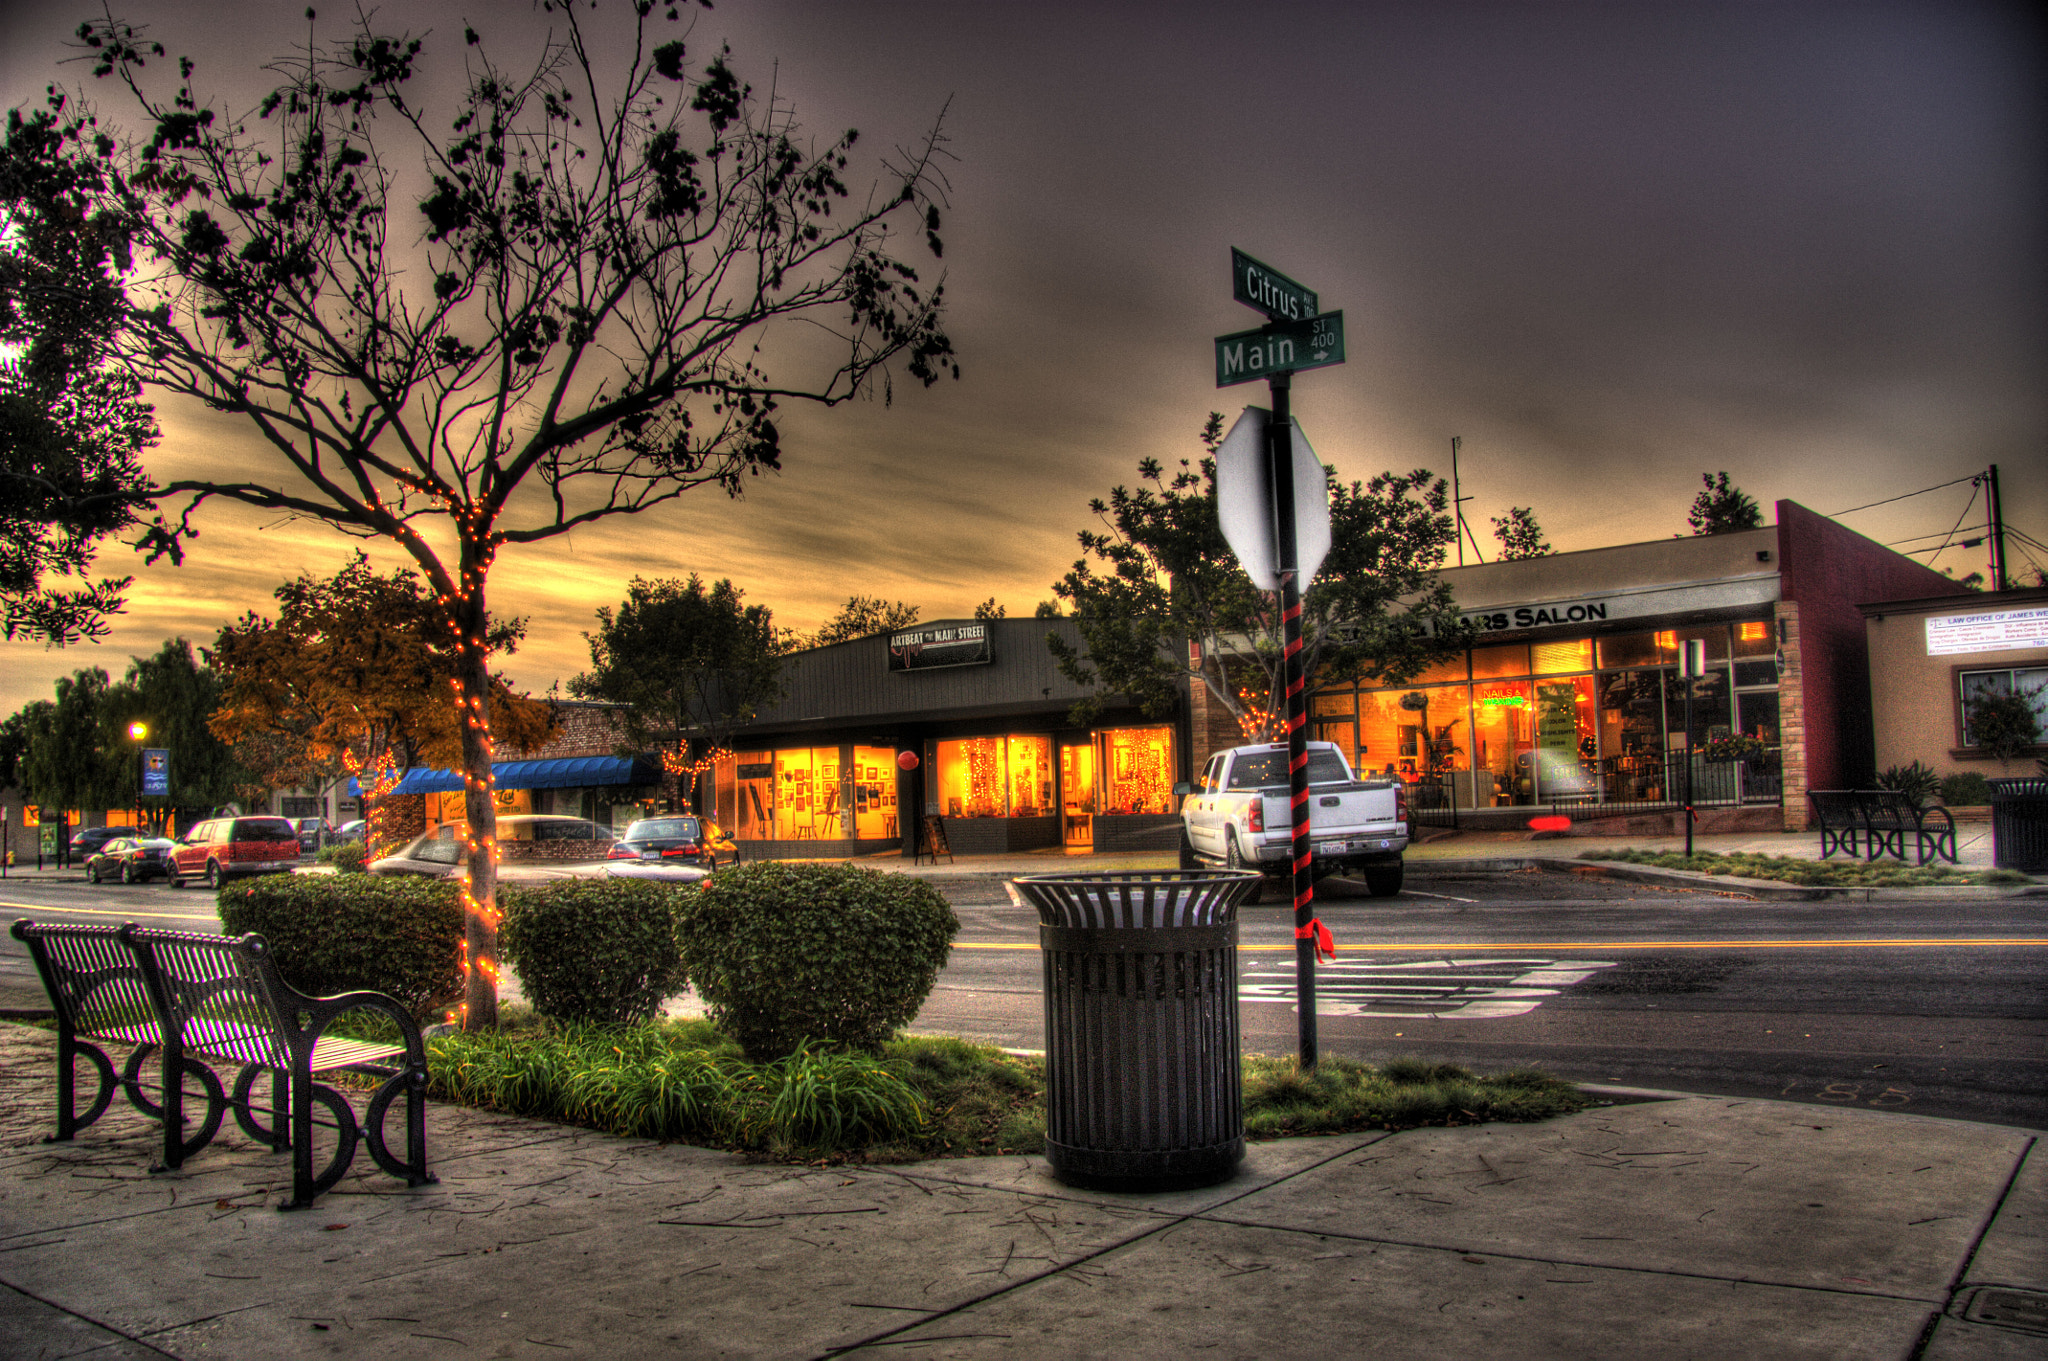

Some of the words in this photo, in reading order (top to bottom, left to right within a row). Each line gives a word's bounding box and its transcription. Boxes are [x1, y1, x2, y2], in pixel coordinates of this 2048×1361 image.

[1247, 266, 1298, 320] Citrus
[1304, 305, 1315, 319] 100
[1223, 336, 1294, 376] Main
[1313, 319, 1326, 334] ST
[1311, 332, 1335, 348] 400
[1514, 602, 1607, 628] SALON
[1947, 617, 1965, 625] LAW
[1966, 615, 1992, 623] OFFICE
[1994, 613, 2005, 621] OF
[2007, 610, 2034, 620] JAMES
[890, 632, 923, 648] ARTBEAT
[935, 629, 956, 643] MAIN
[958, 625, 985, 640] STREET
[1483, 688, 1513, 698] NAILS
